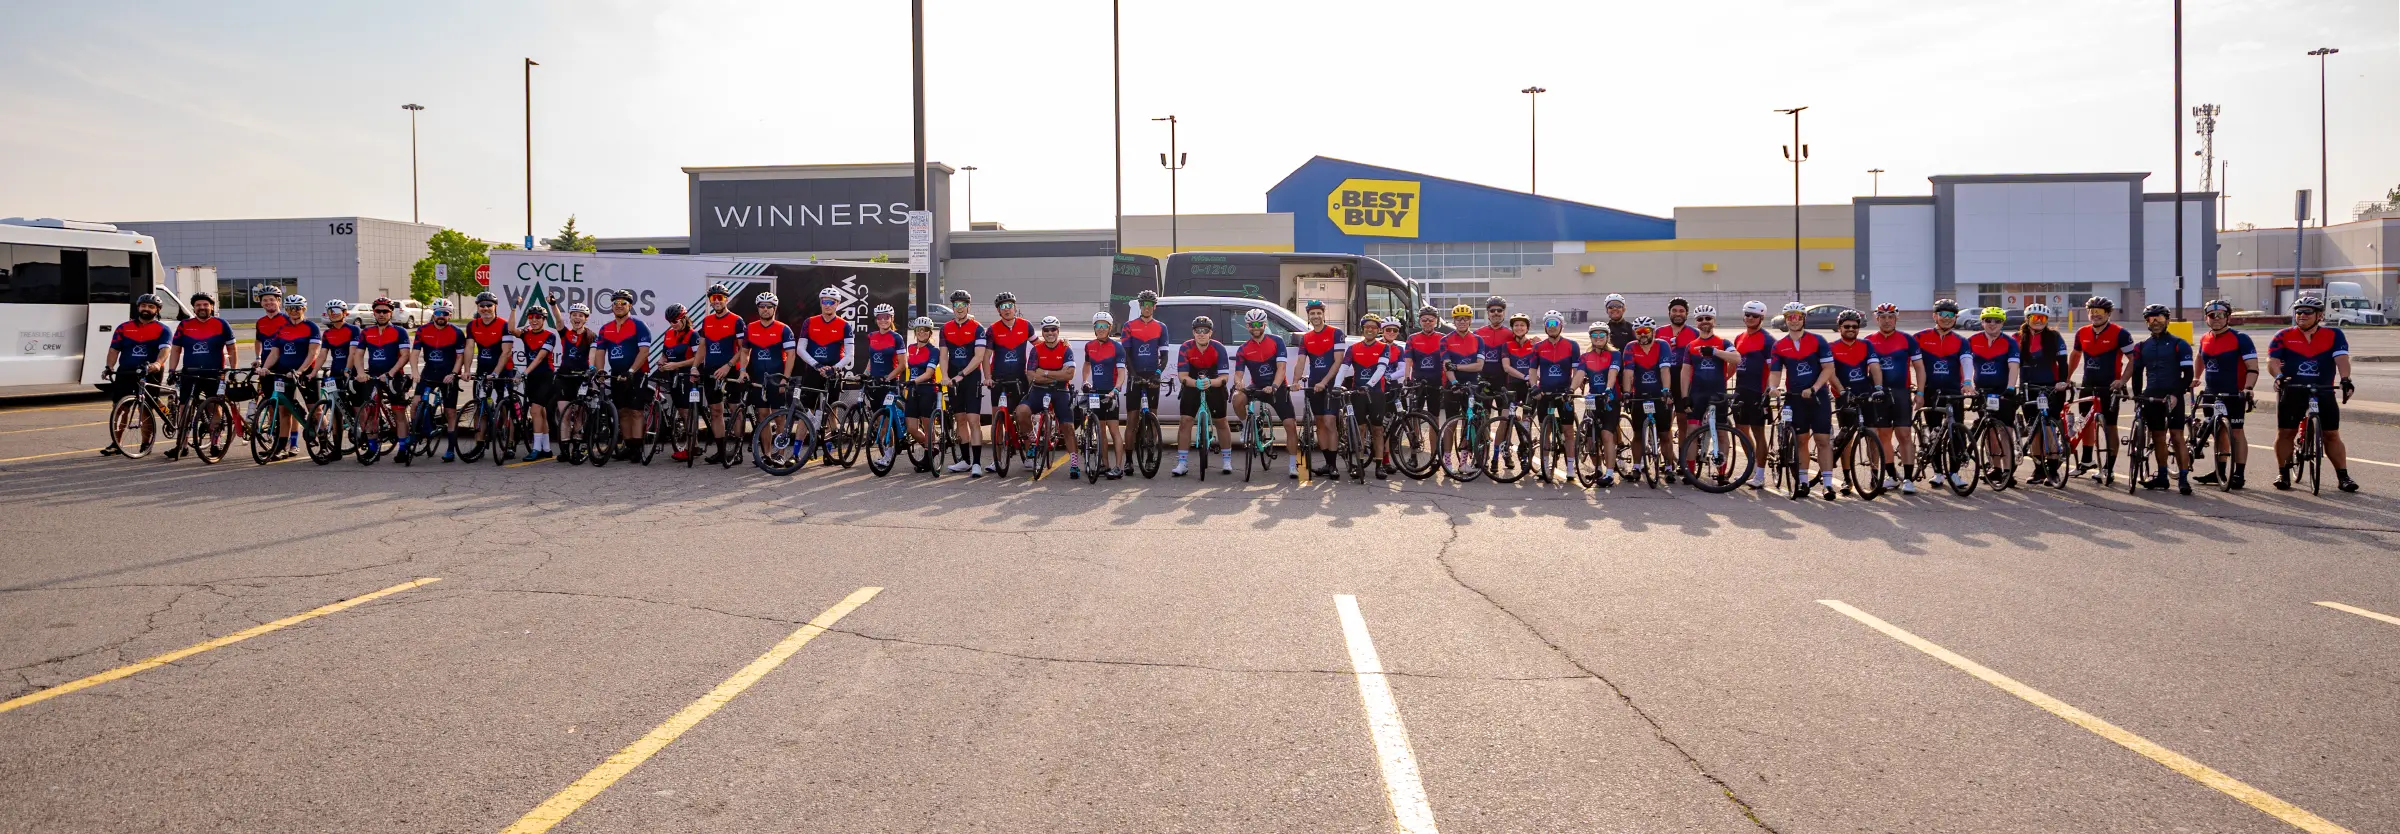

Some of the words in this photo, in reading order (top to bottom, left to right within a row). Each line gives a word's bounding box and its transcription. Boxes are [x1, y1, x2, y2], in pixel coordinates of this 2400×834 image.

[1342, 190, 1414, 209] BEST
[714, 203, 910, 227] WINNERS
[1345, 209, 1408, 227] BUY
[329, 223, 353, 235] 165
[477, 270, 490, 280] STO
[517, 262, 584, 282] CYCLE
[857, 284, 868, 332] CYCLE
[42, 343, 62, 351] CREW
